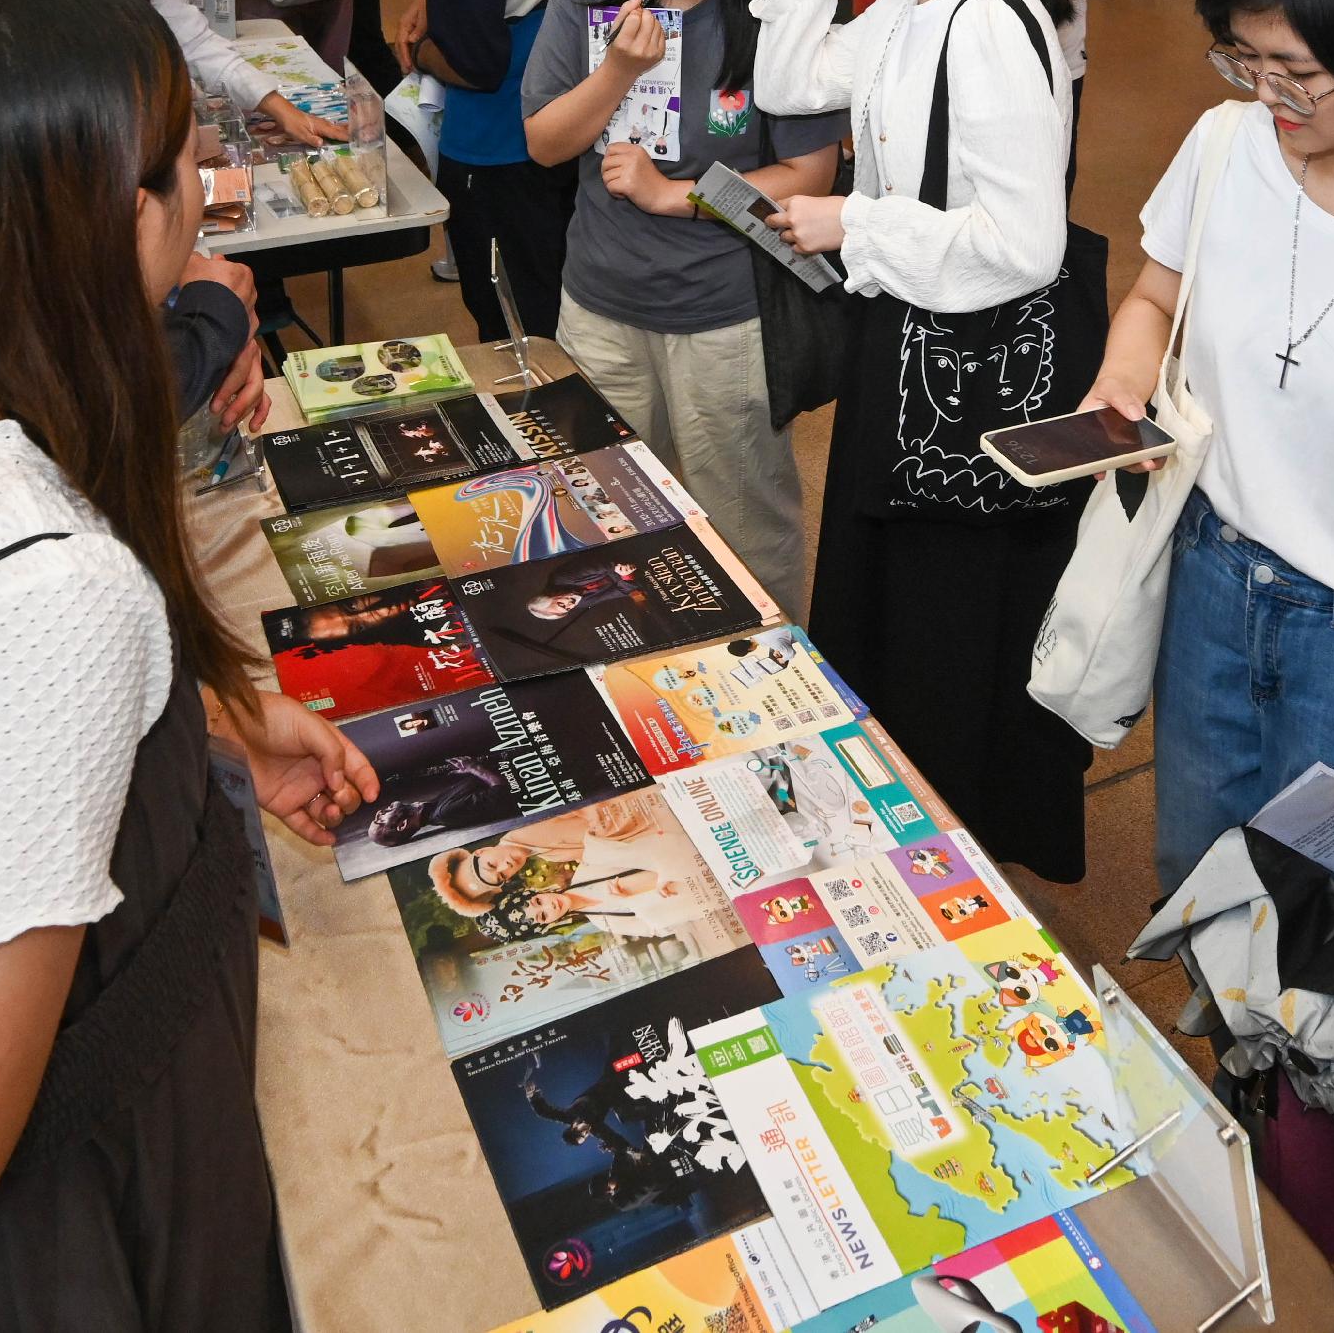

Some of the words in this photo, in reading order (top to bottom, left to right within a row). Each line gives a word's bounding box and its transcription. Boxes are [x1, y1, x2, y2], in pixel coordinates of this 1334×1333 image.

[505, 410, 562, 459] KISSIN
[299, 536, 349, 597] 空山新雨後
[322, 533, 345, 555] Rain
[342, 568, 367, 591] After
[644, 556, 698, 613] Krystian
[407, 596, 467, 671] 花木蘭
[465, 686, 534, 755] Azmeh
[502, 750, 568, 817] Kinan
[681, 775, 725, 822] ONLINE
[708, 820, 762, 881] SCIENCE
[630, 1028, 658, 1062] WING
[640, 1023, 668, 1058] CHUN
[712, 1048, 729, 1067] 137
[729, 1043, 745, 1062] 2024
[794, 1136, 874, 1271] NEWSLETTER
